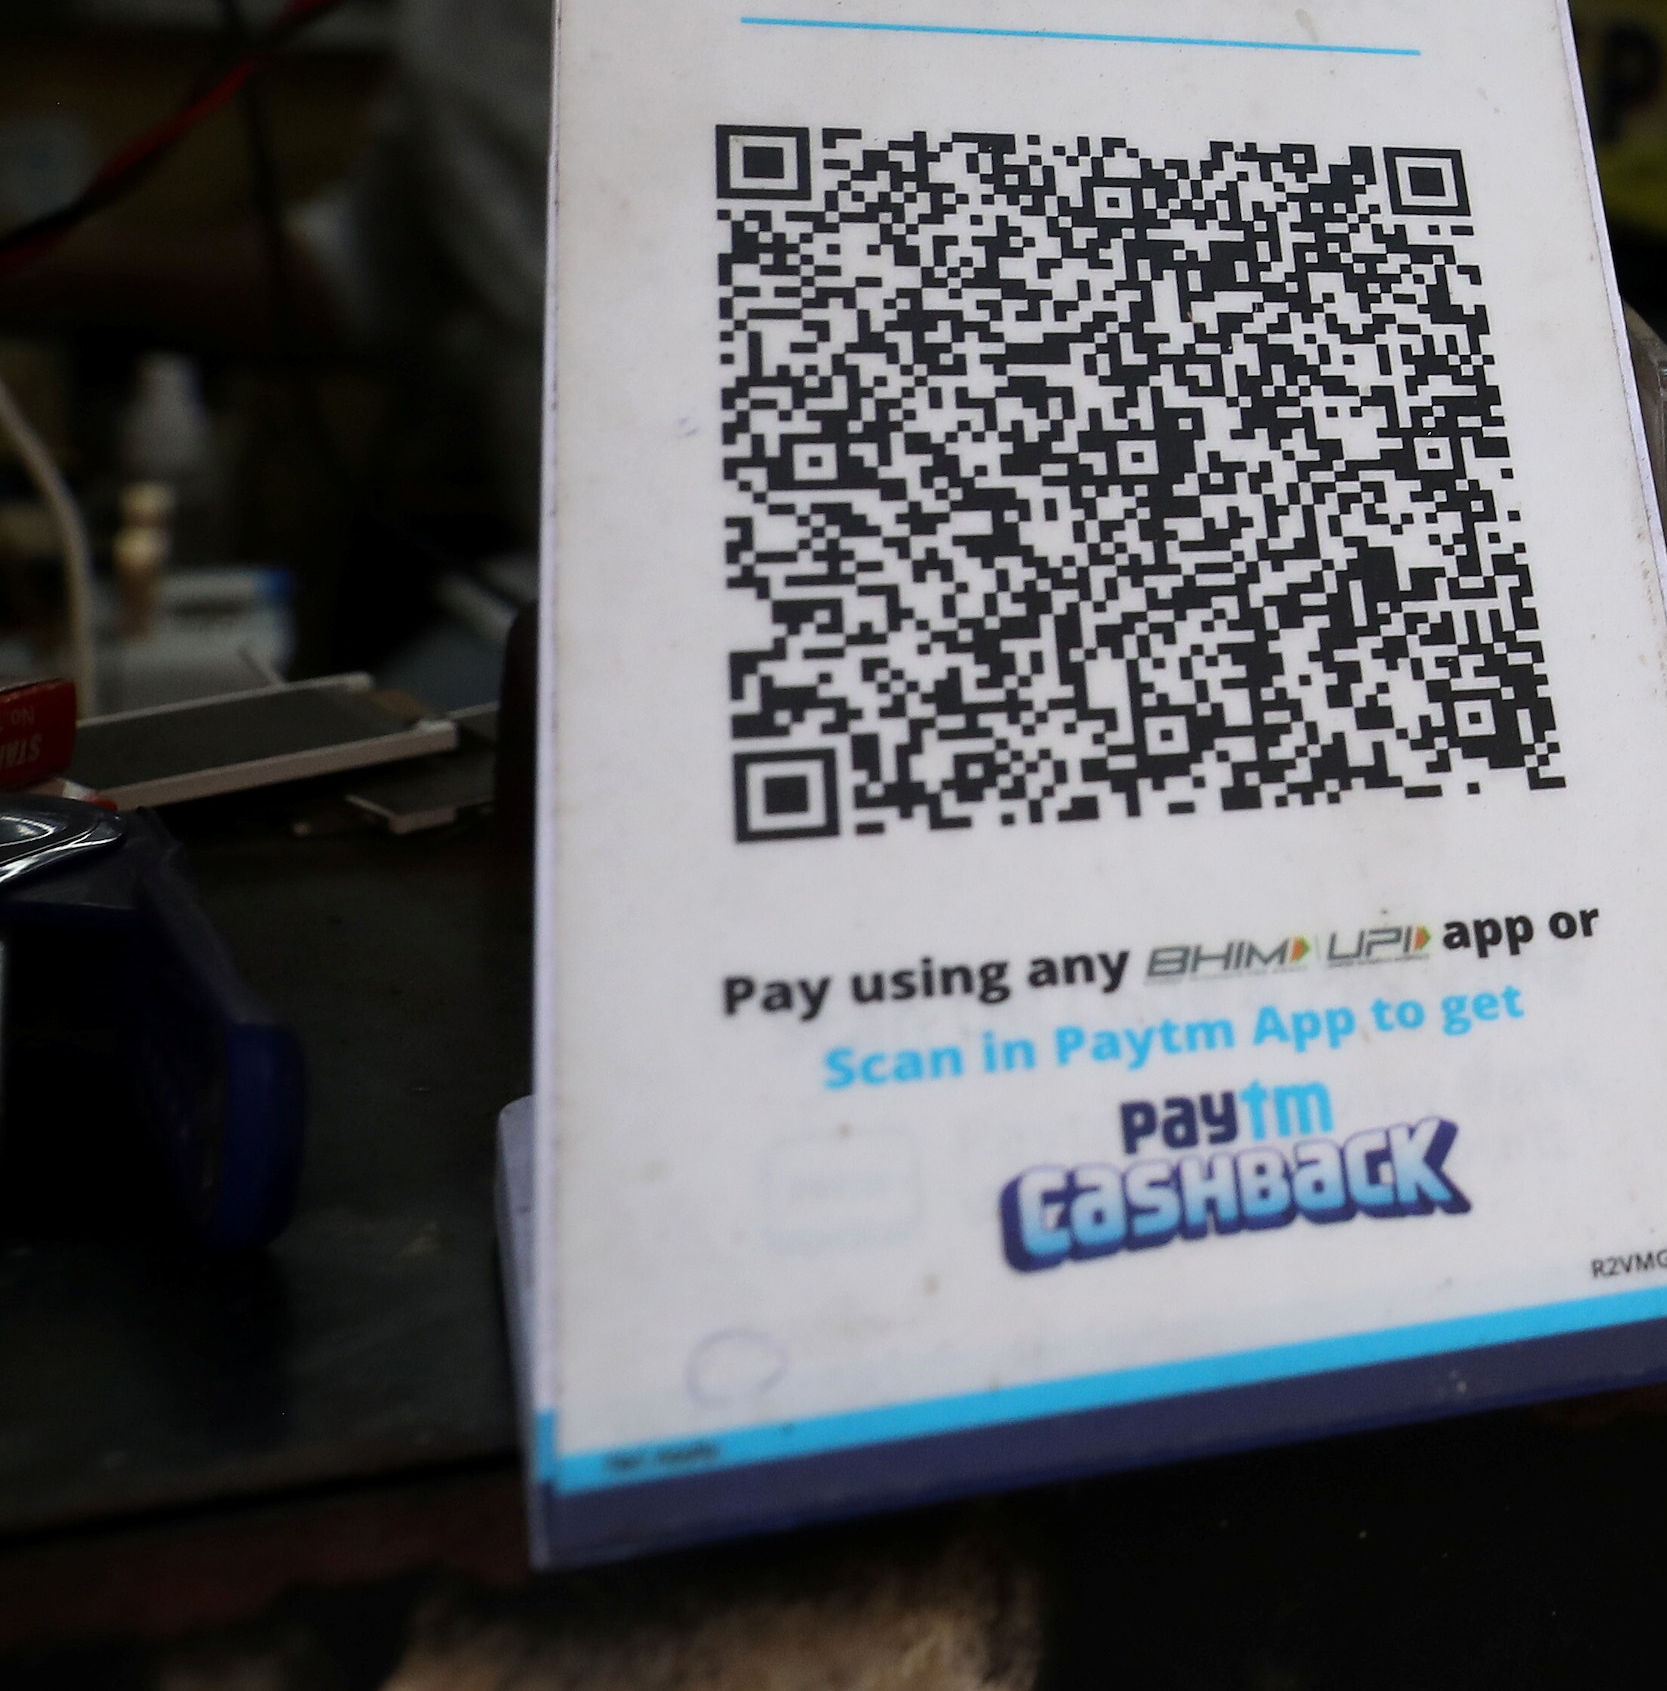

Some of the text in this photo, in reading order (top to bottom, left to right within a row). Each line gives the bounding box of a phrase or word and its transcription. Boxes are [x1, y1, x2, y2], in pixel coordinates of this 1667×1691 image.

[723, 975, 832, 1022] Pay
[851, 956, 1011, 1005] using
[1027, 950, 1130, 993] any
[1147, 938, 1291, 977] BHIM
[1326, 926, 1414, 962] UPI
[1443, 914, 1534, 958] app
[1548, 908, 1599, 940] or
[824, 985, 1525, 1090] Scan in Paytm App to get
